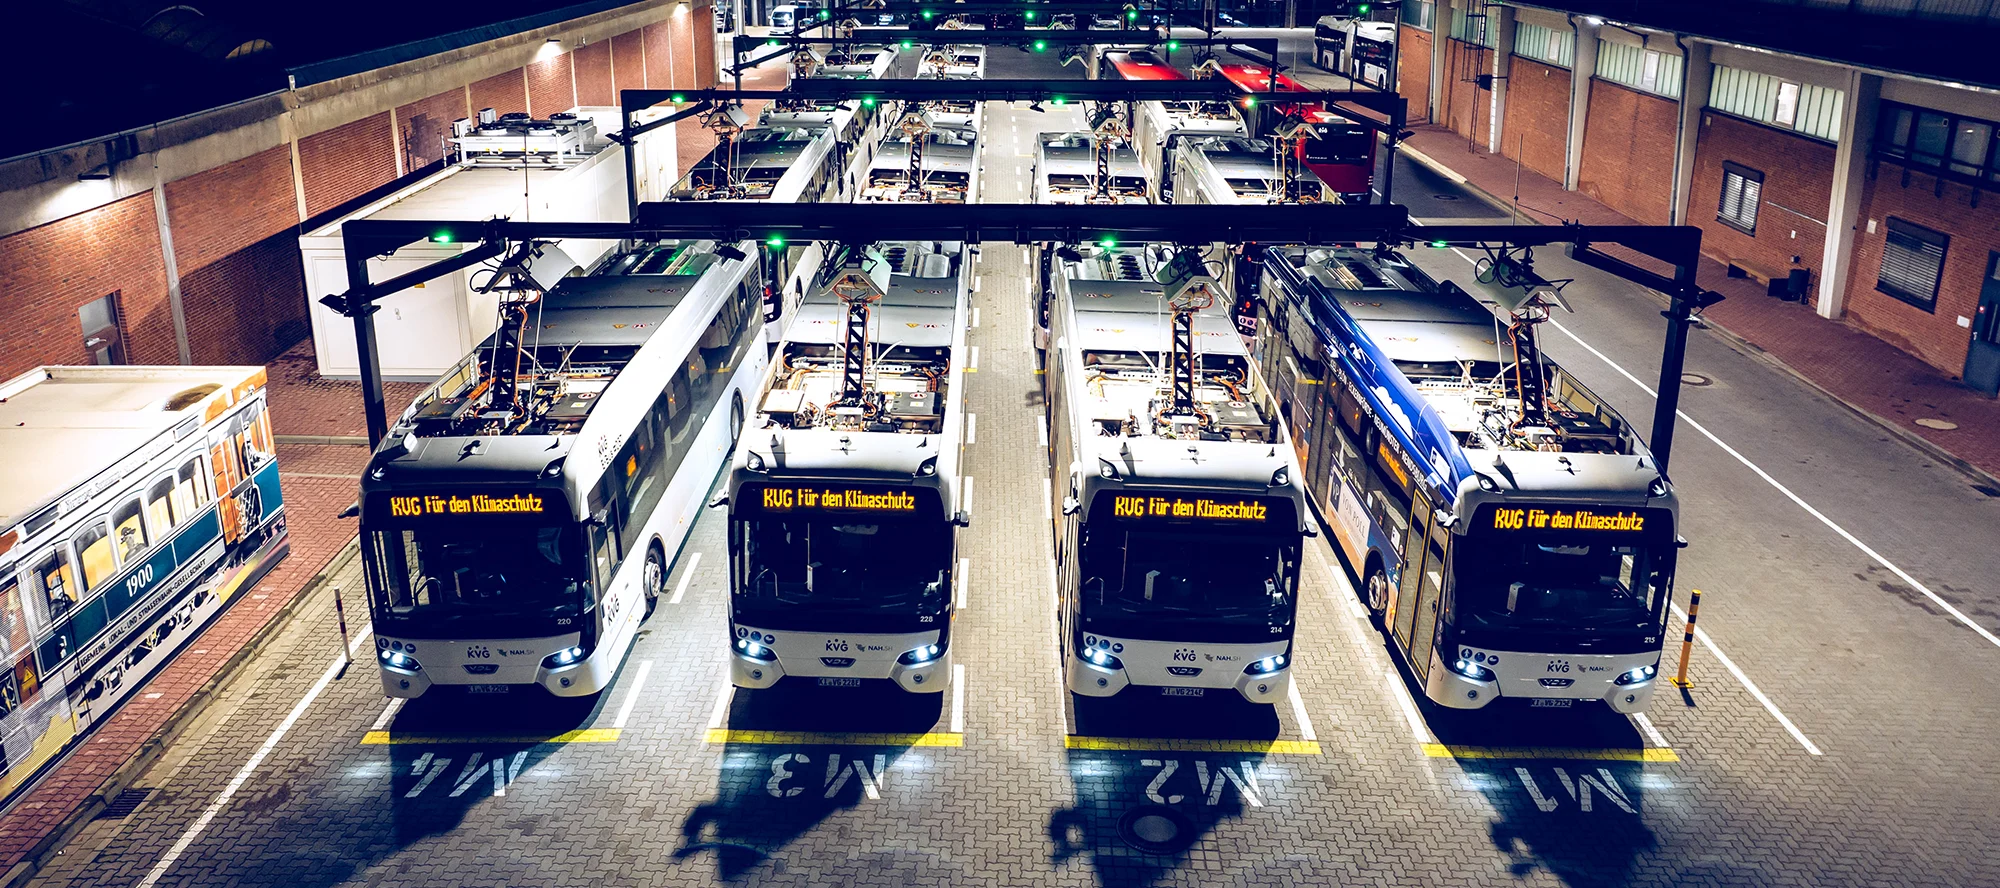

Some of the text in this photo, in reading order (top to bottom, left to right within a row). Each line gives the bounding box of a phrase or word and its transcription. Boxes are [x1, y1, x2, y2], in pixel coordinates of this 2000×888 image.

[1373, 413, 1400, 455] NEUMÜNSTER
[1401, 450, 1428, 491] RENDSBURG
[390, 493, 543, 516] KVG Für den Klimaschutz
[763, 488, 915, 510] KVG Für den Klimaschutz
[1115, 496, 1267, 520] KVG Für den Klimaschutz
[1494, 508, 1645, 531] KVG Für den Klimaschutz
[126, 563, 153, 597] 1900
[467, 650, 490, 658] KVG
[826, 643, 849, 652] KVG
[1174, 653, 1196, 661] KVG
[1547, 664, 1570, 673] KVG
[404, 751, 528, 798] M4
[766, 754, 886, 799] M3
[1141, 759, 1264, 807] M2
[1514, 767, 1638, 813] M1
